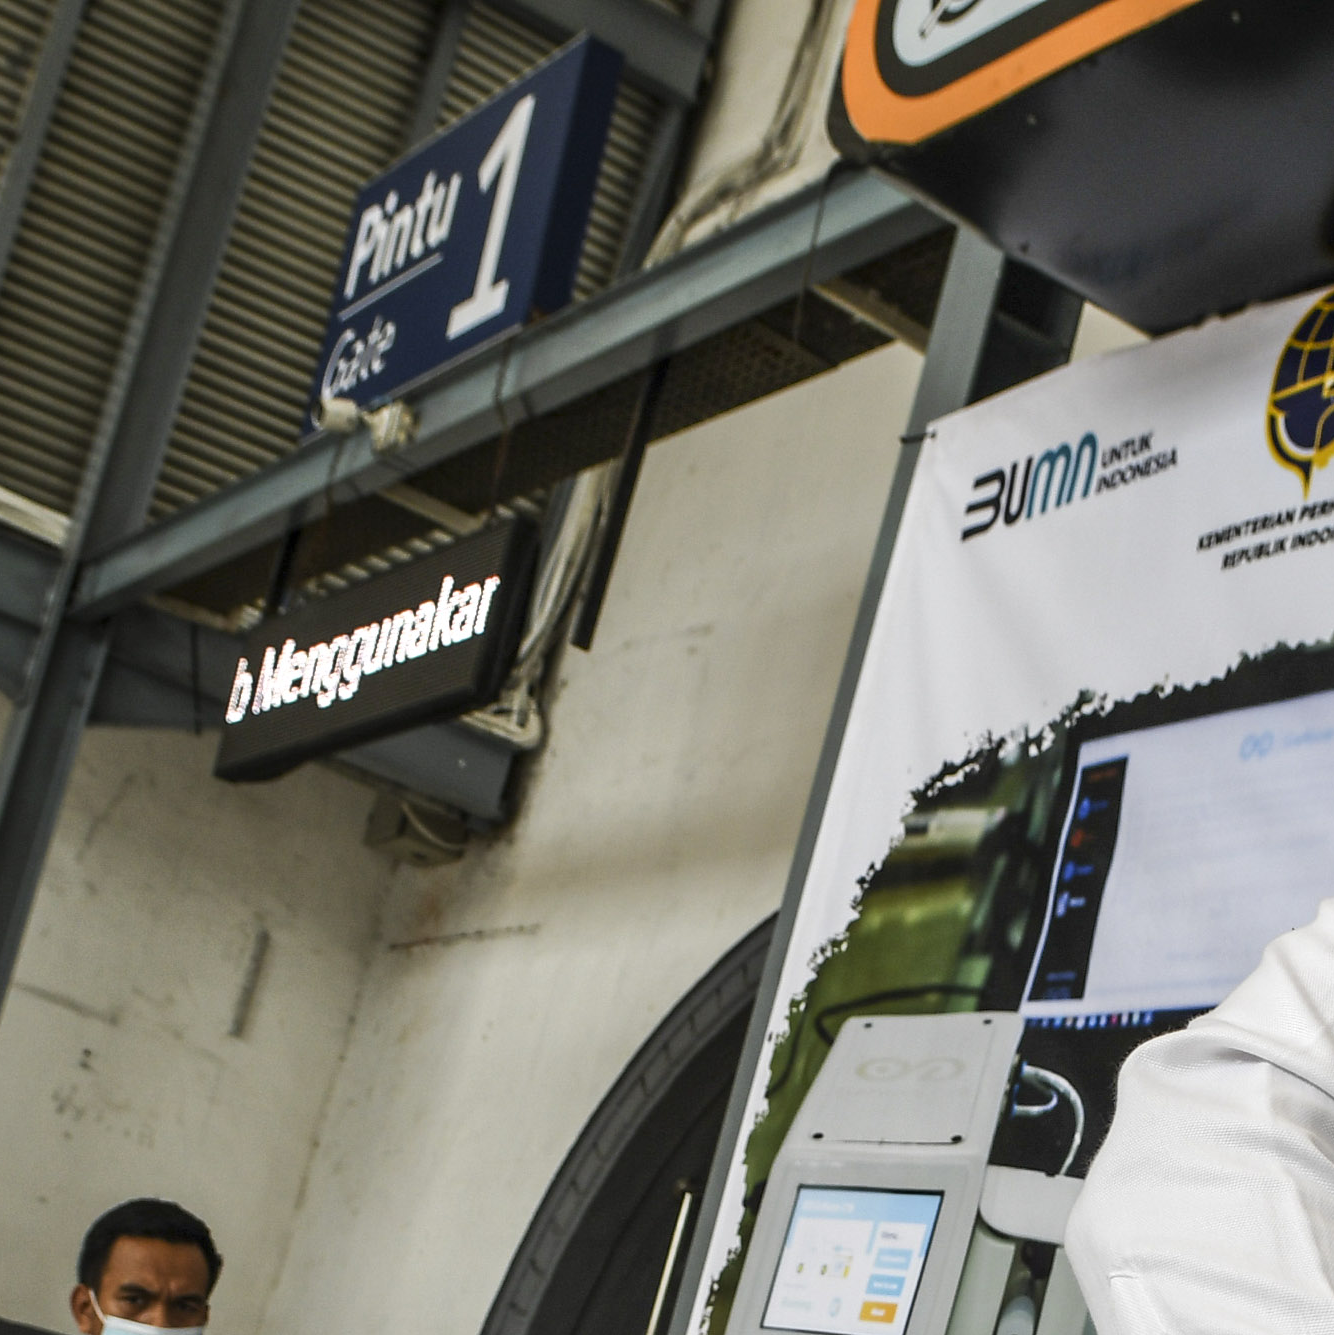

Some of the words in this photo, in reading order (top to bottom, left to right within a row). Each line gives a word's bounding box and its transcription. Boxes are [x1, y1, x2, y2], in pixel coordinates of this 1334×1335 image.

[343, 169, 463, 300] Pintu
[445, 92, 536, 341] 1
[1095, 447, 1178, 494] INDONESIA
[1101, 432, 1154, 469] UNTUK
[1196, 508, 1298, 552] KEMENTERIAN
[1221, 535, 1289, 570] REPUBLIK
